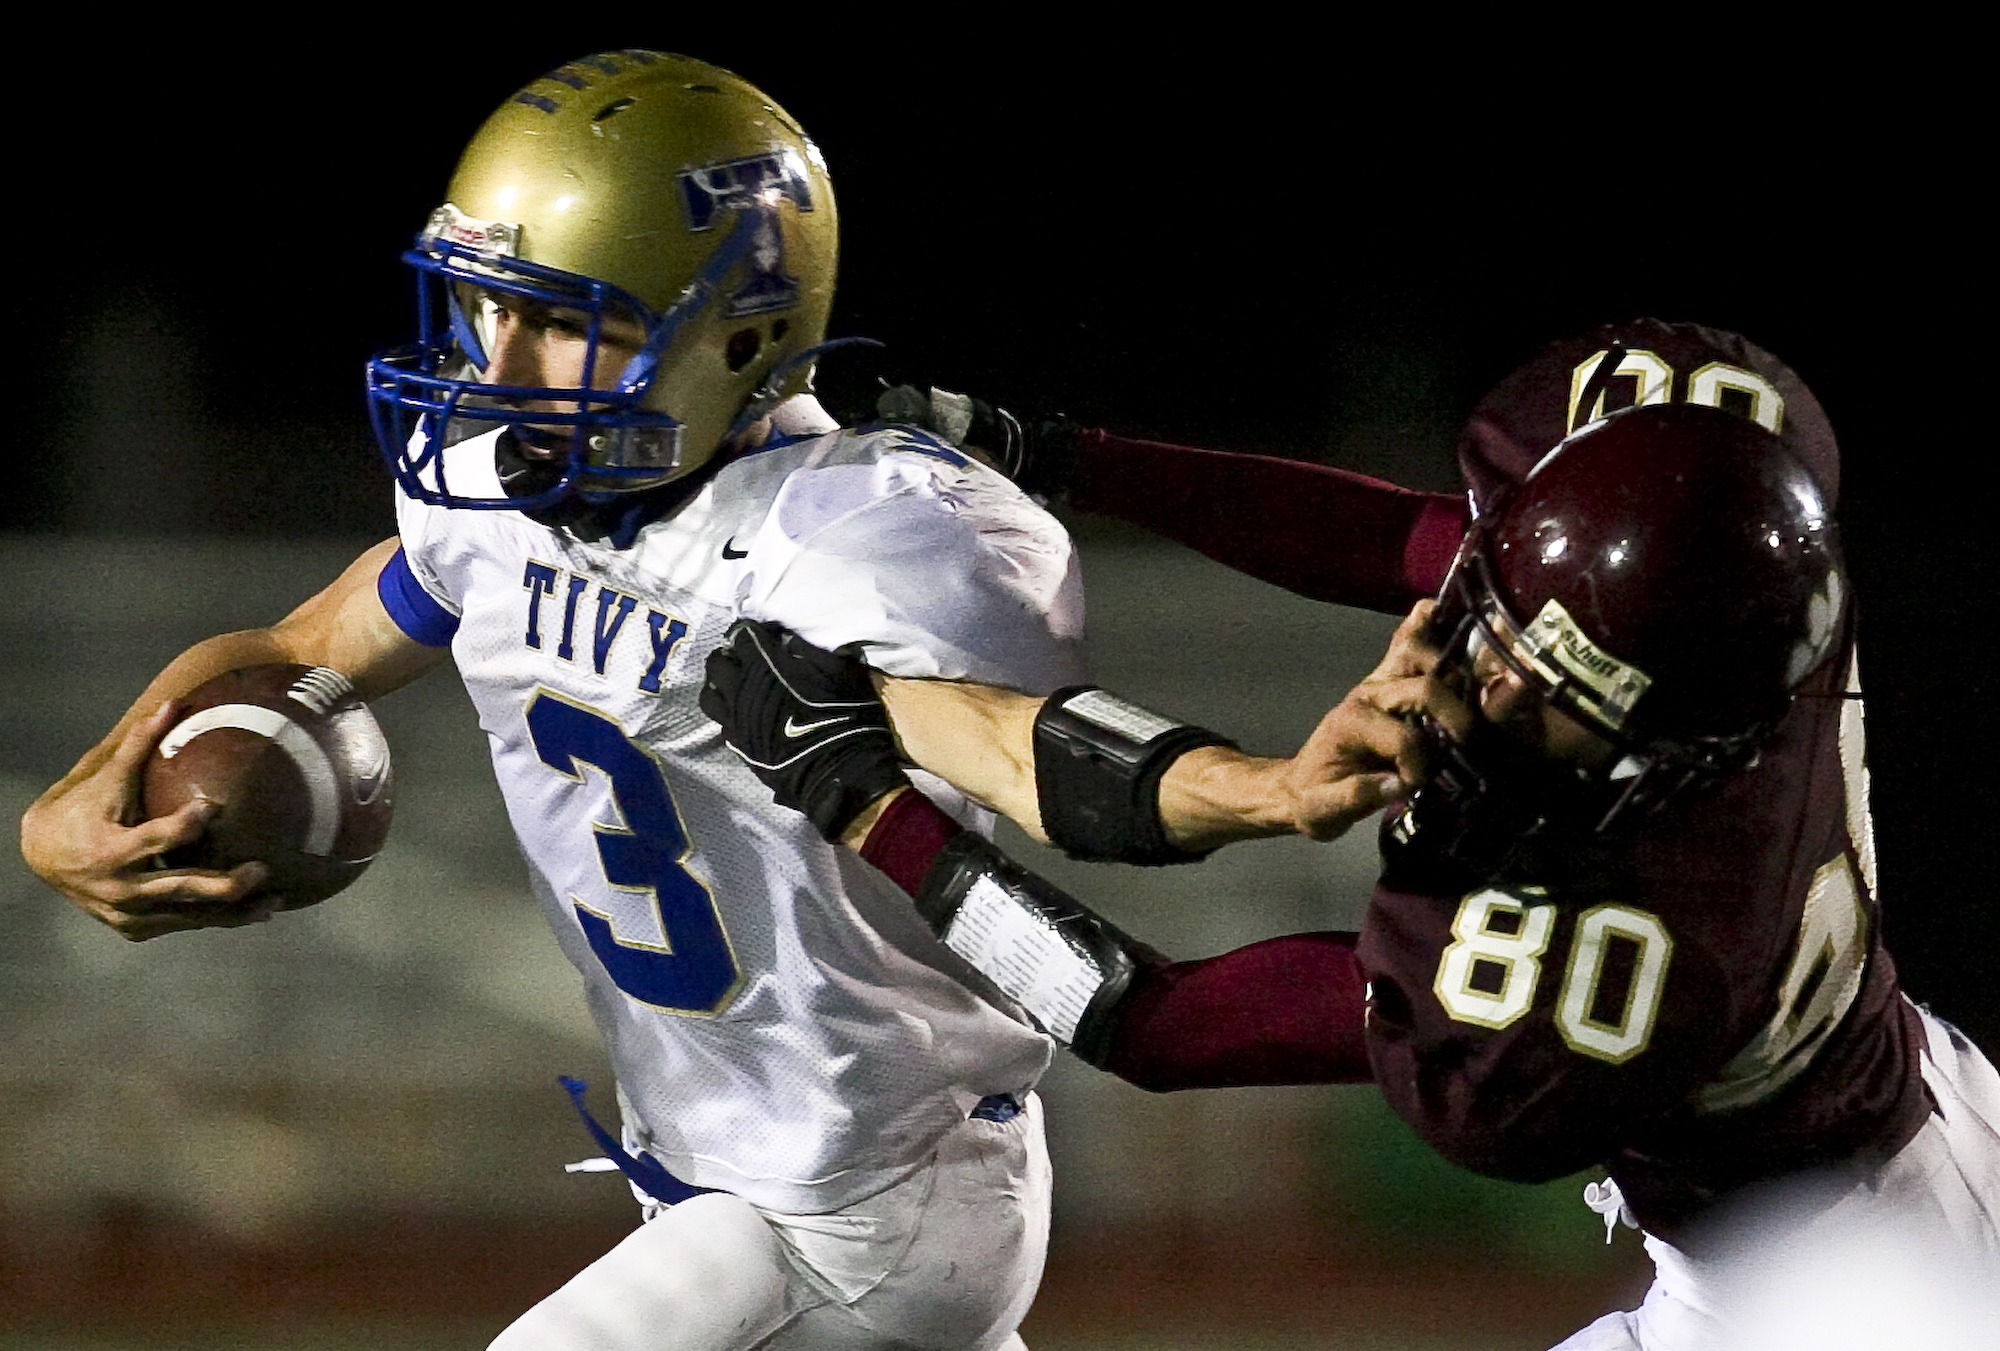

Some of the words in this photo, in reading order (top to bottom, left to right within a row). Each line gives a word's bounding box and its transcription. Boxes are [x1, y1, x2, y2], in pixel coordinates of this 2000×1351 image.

[522, 557, 689, 695] TIVY
[522, 682, 748, 1018] 3
[1432, 885, 1673, 1065] 80
